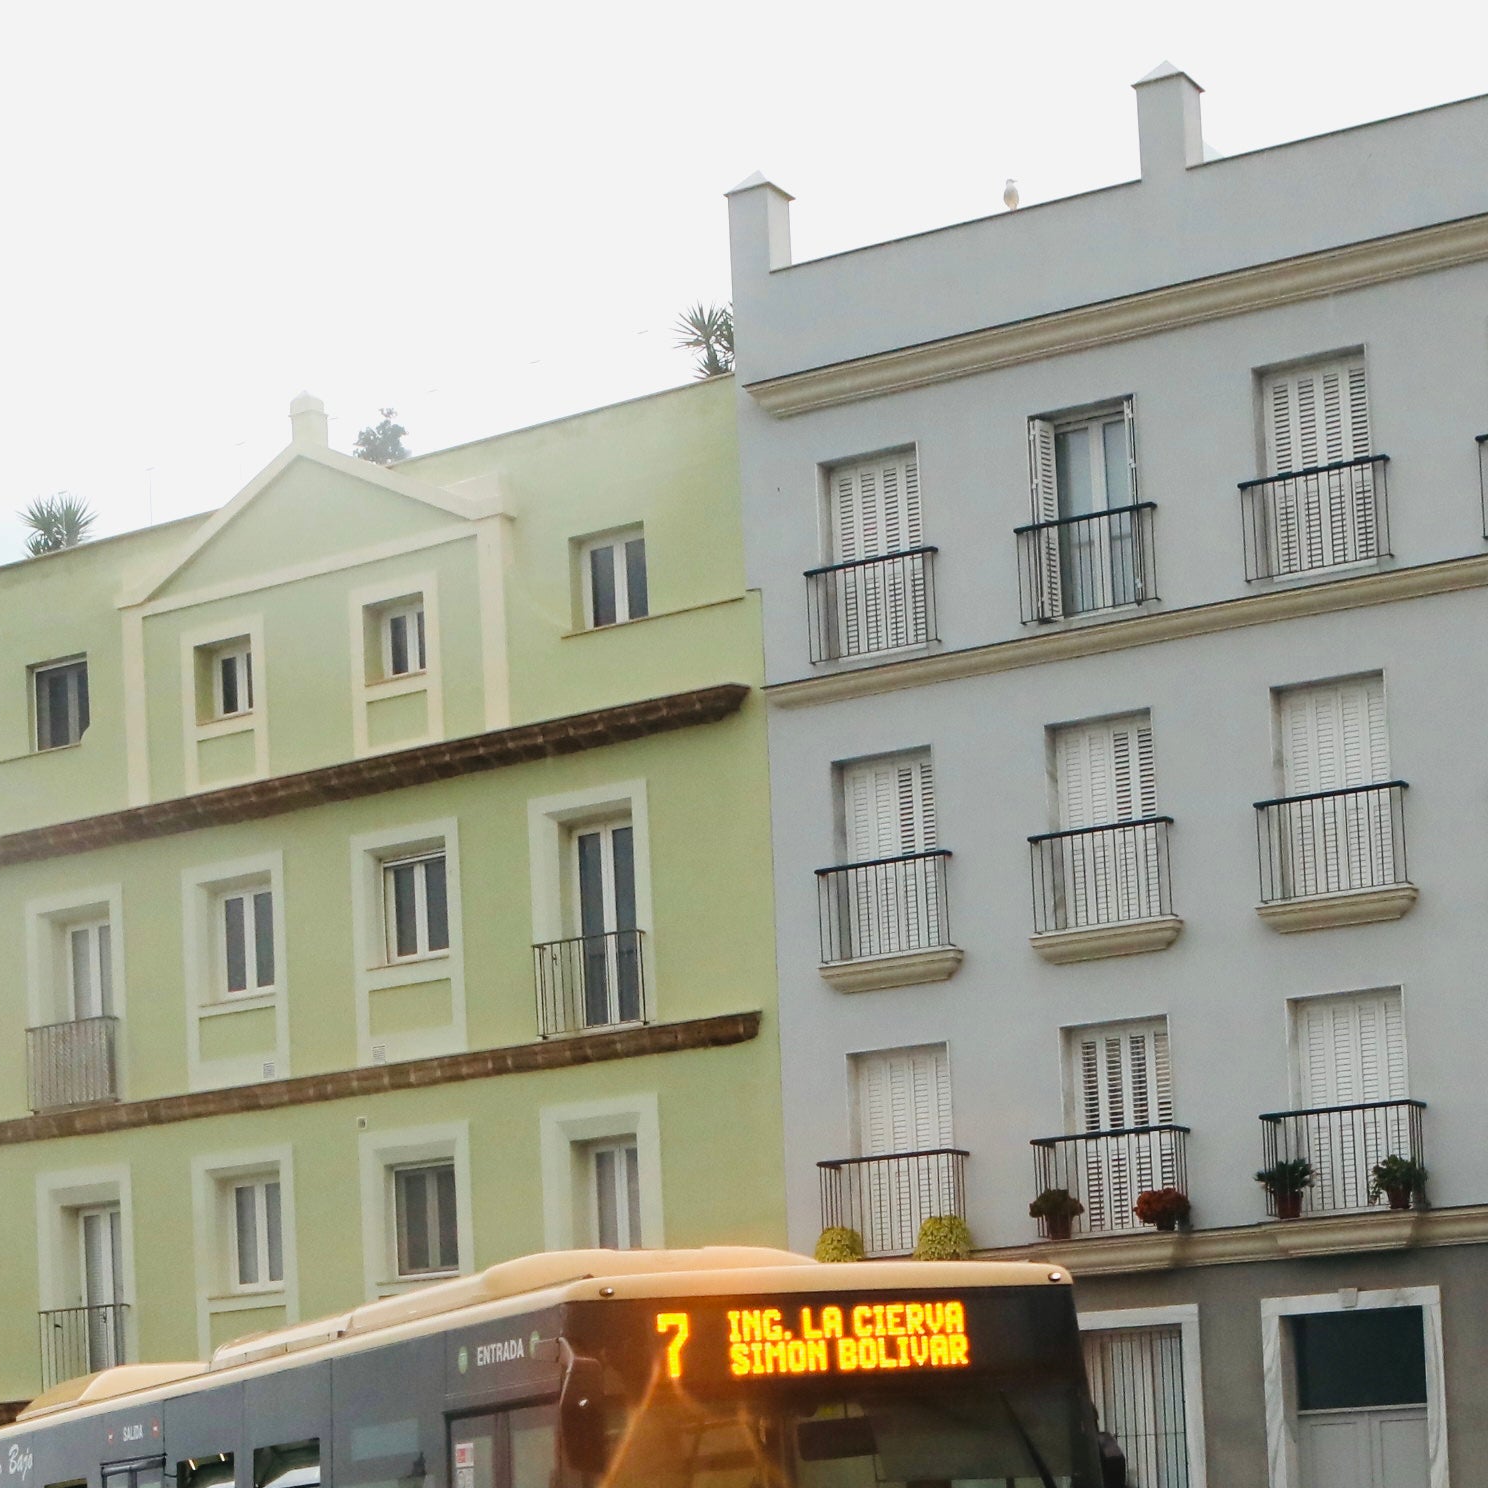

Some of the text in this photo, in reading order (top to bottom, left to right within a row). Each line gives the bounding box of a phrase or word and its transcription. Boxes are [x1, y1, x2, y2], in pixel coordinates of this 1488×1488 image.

[728, 1302, 965, 1342] ING. LA CIERVA
[477, 1338, 525, 1366] ENTRADA
[657, 1313, 688, 1378] 7
[730, 1334, 969, 1376] SIMON BOLIVAR
[123, 1424, 143, 1442] SALIDA
[8, 1443, 33, 1481] Bajo
